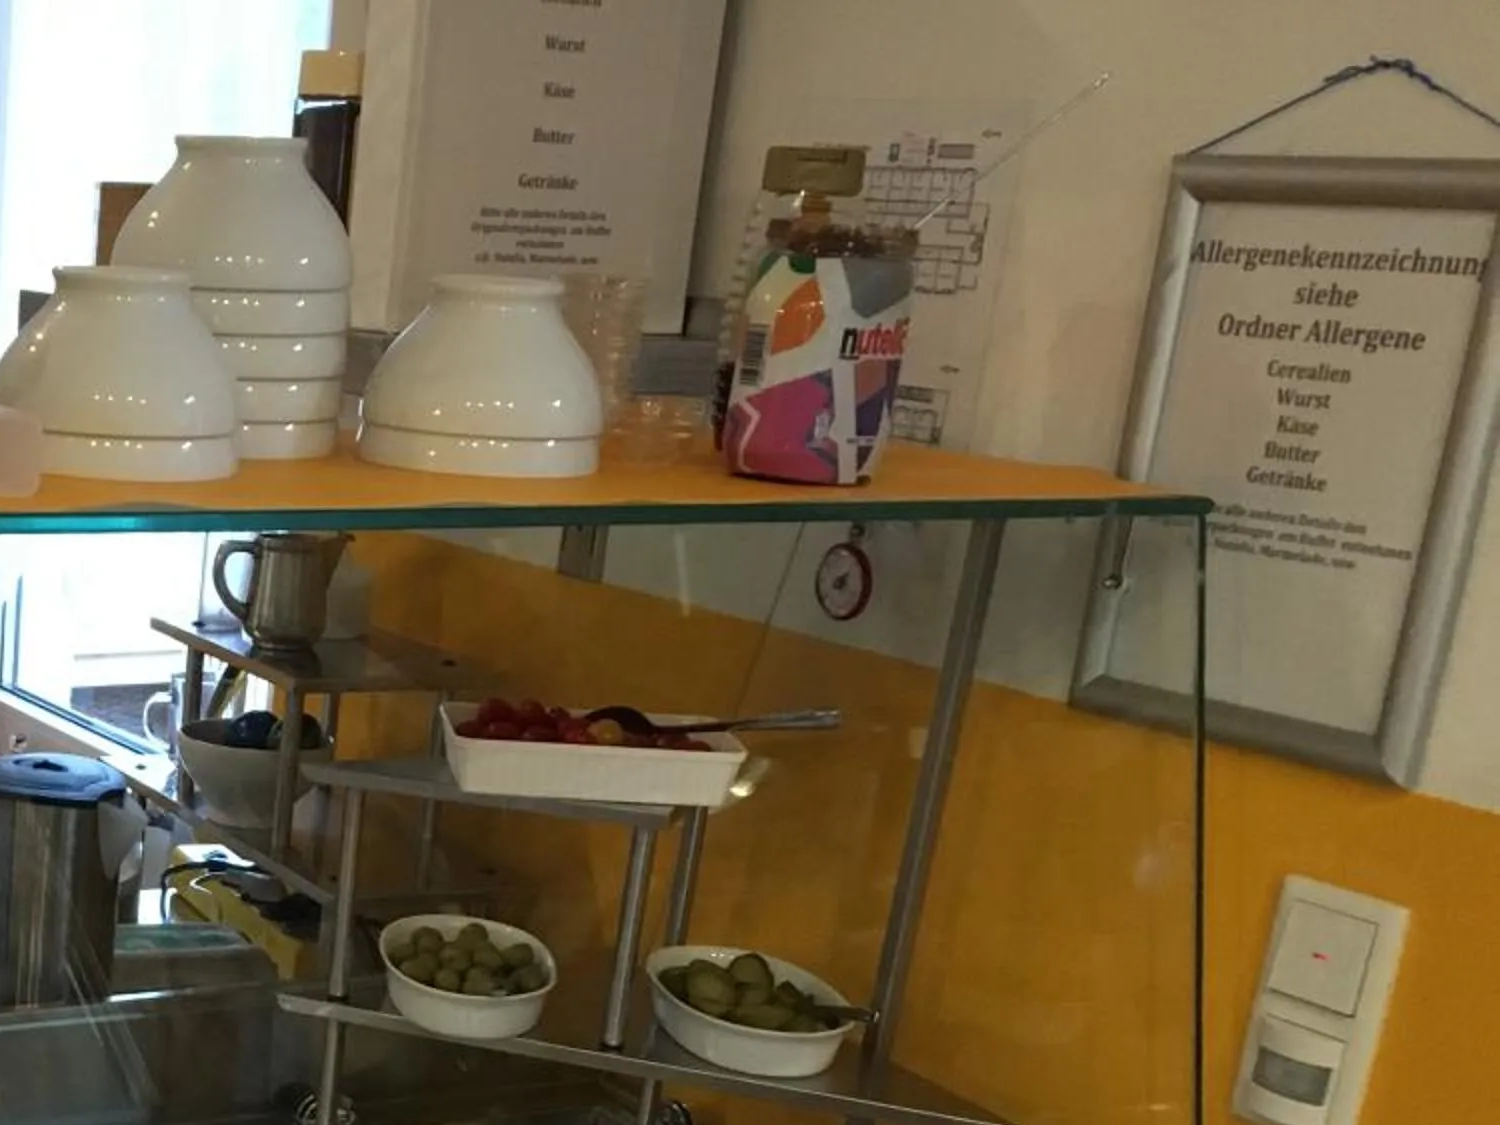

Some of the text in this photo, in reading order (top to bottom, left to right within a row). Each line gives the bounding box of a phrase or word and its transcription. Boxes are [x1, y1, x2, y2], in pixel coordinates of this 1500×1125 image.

[1294, 282, 1358, 307] siehe
[1217, 313, 1426, 353] Ordner Allergene
[1267, 359, 1352, 384] Cerealien
[1276, 388, 1332, 409] Wurst
[1264, 441, 1321, 463] Butter
[1246, 466, 1327, 492] Getränke
